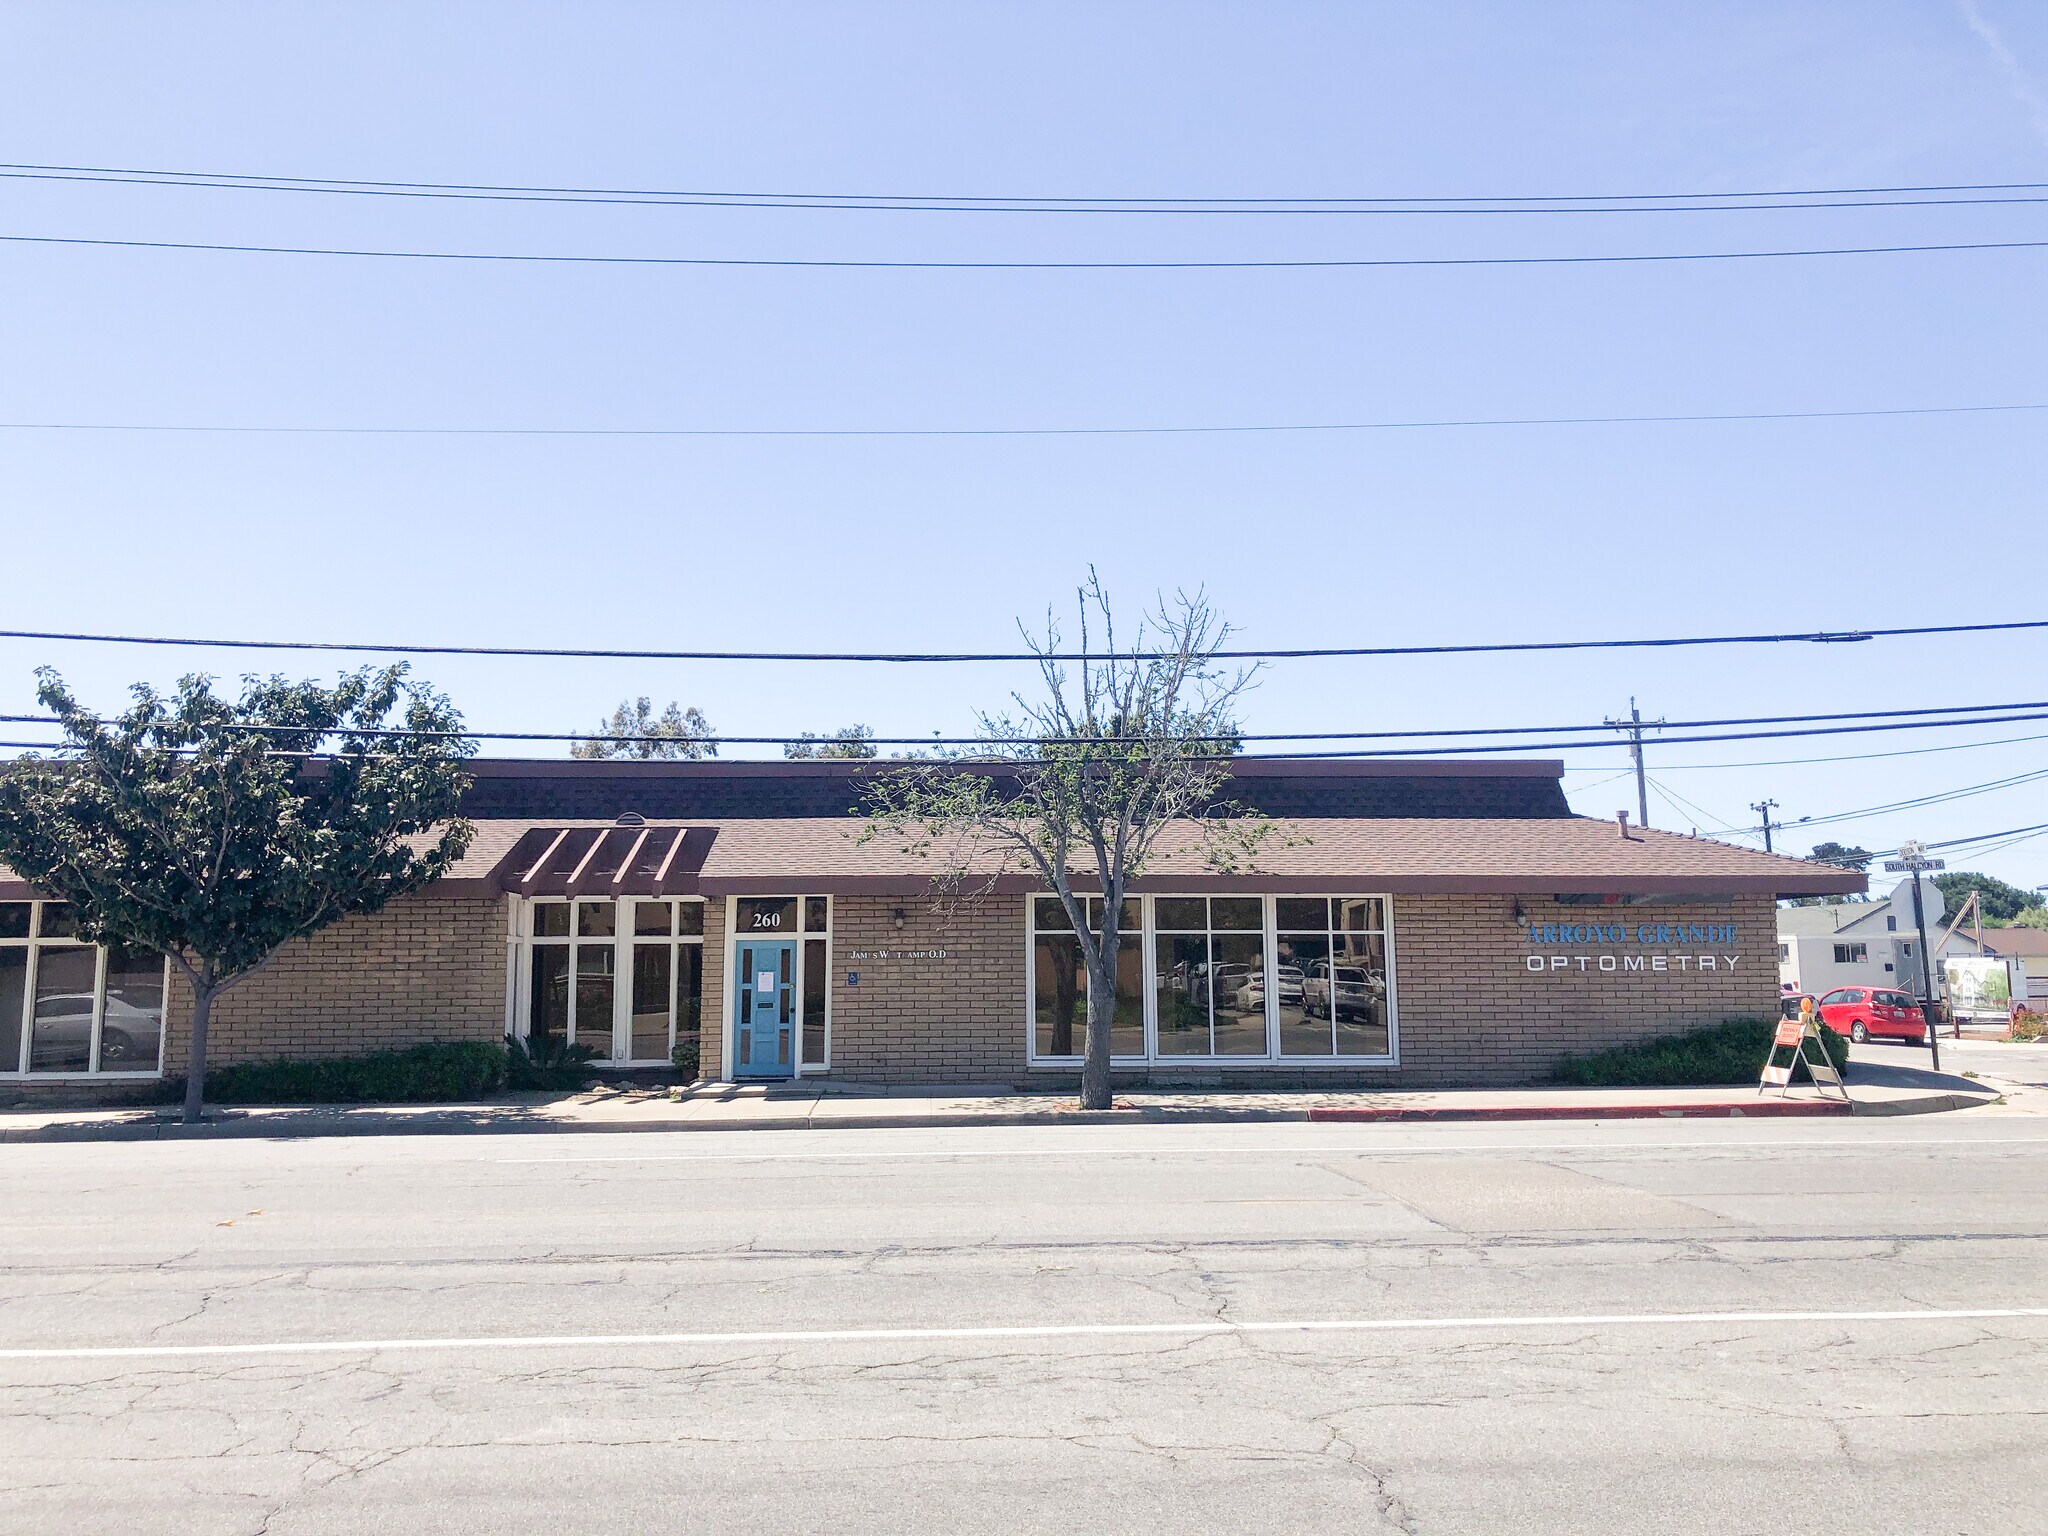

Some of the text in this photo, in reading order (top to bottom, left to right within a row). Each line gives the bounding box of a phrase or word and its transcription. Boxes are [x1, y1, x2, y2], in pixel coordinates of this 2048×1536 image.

[1906, 861, 1933, 870] HALCYON
[753, 912, 781, 928] 260
[1526, 924, 1739, 944] ARROYO GRANDE
[1526, 955, 1741, 972] OPTOMETRY
